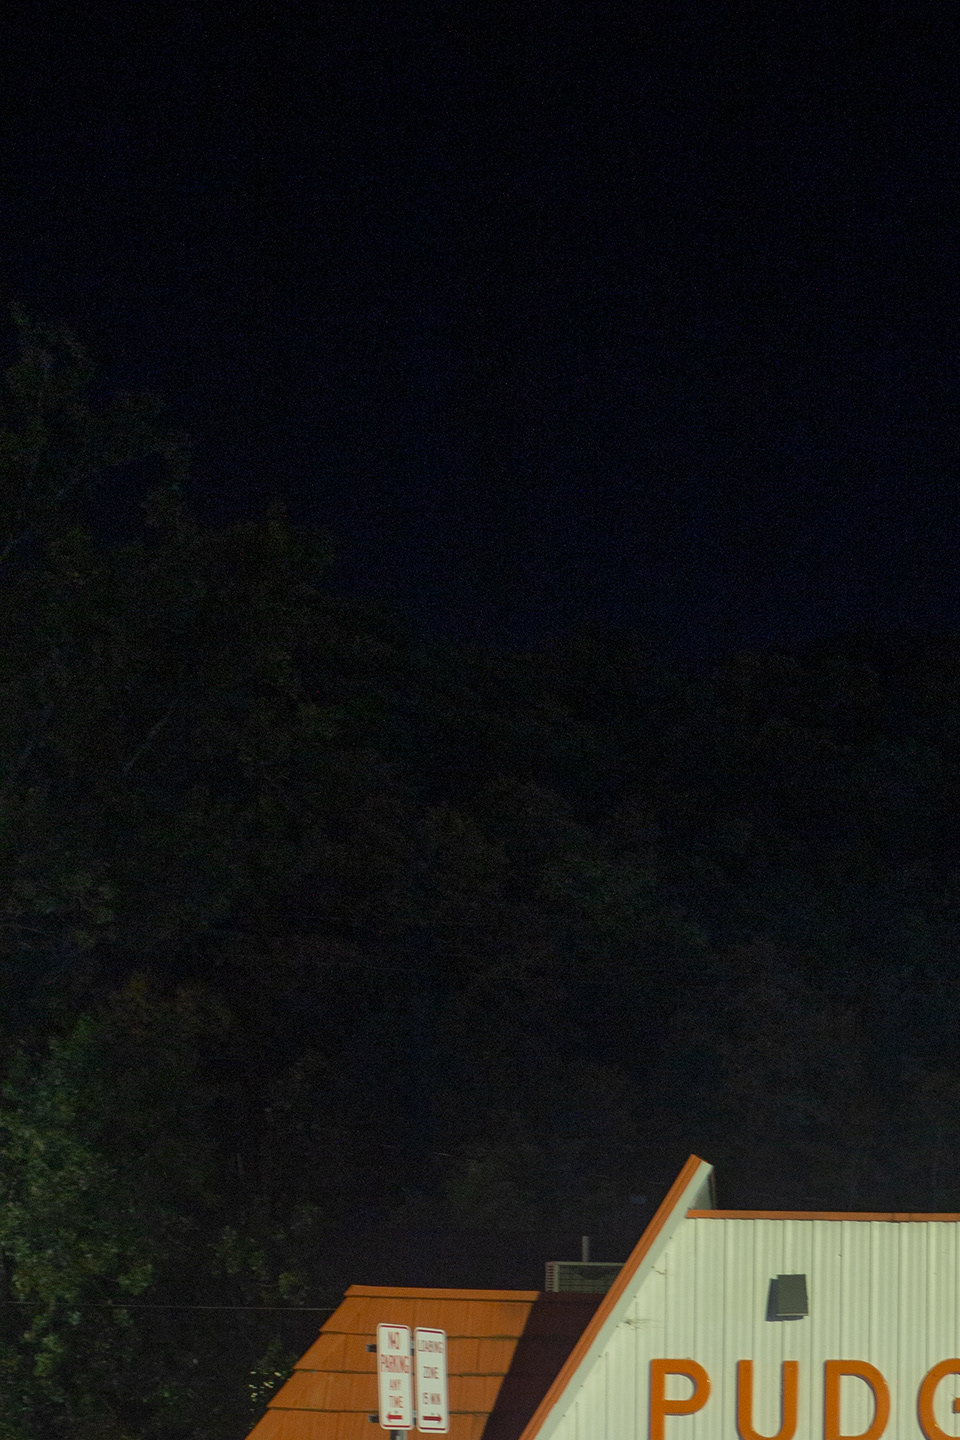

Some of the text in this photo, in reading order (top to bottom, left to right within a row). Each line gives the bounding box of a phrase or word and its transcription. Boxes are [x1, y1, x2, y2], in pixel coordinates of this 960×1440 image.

[389, 1331, 400, 1350] NO
[417, 1339, 443, 1353] LOADING
[380, 1354, 410, 1374] PARKING
[390, 1379, 402, 1391] ANY
[388, 1395, 404, 1408] TIME
